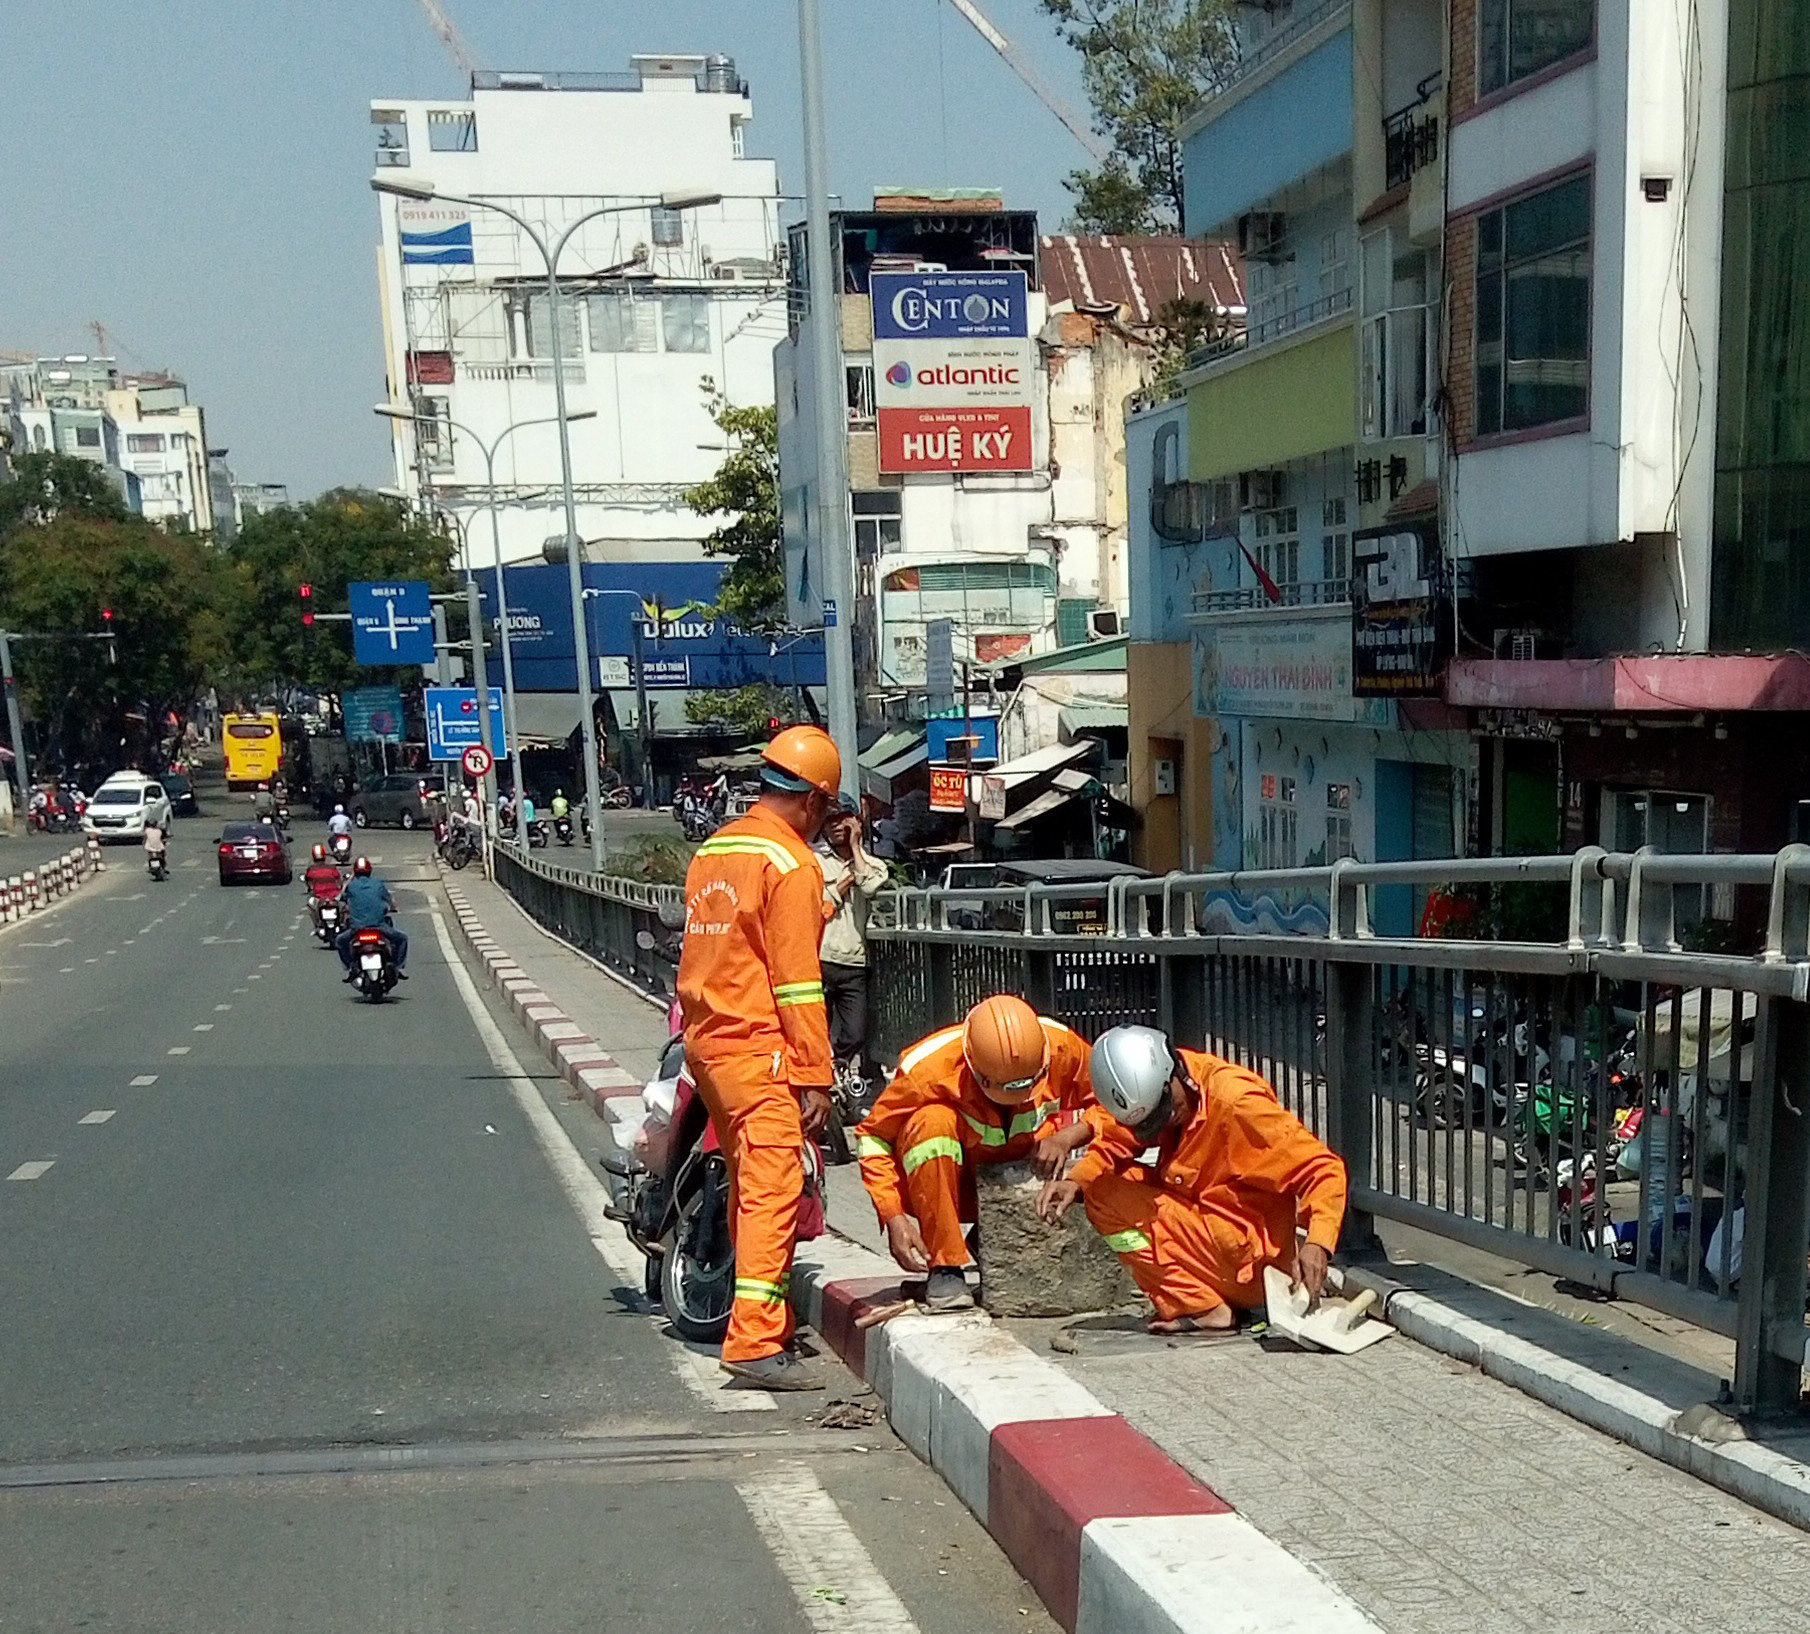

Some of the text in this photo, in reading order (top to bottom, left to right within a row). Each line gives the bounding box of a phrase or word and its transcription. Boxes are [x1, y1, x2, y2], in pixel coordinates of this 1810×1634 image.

[892, 287, 1010, 331] CENTON
[917, 364, 1020, 385] atlantic
[903, 425, 1013, 467] HUỆ KÝ
